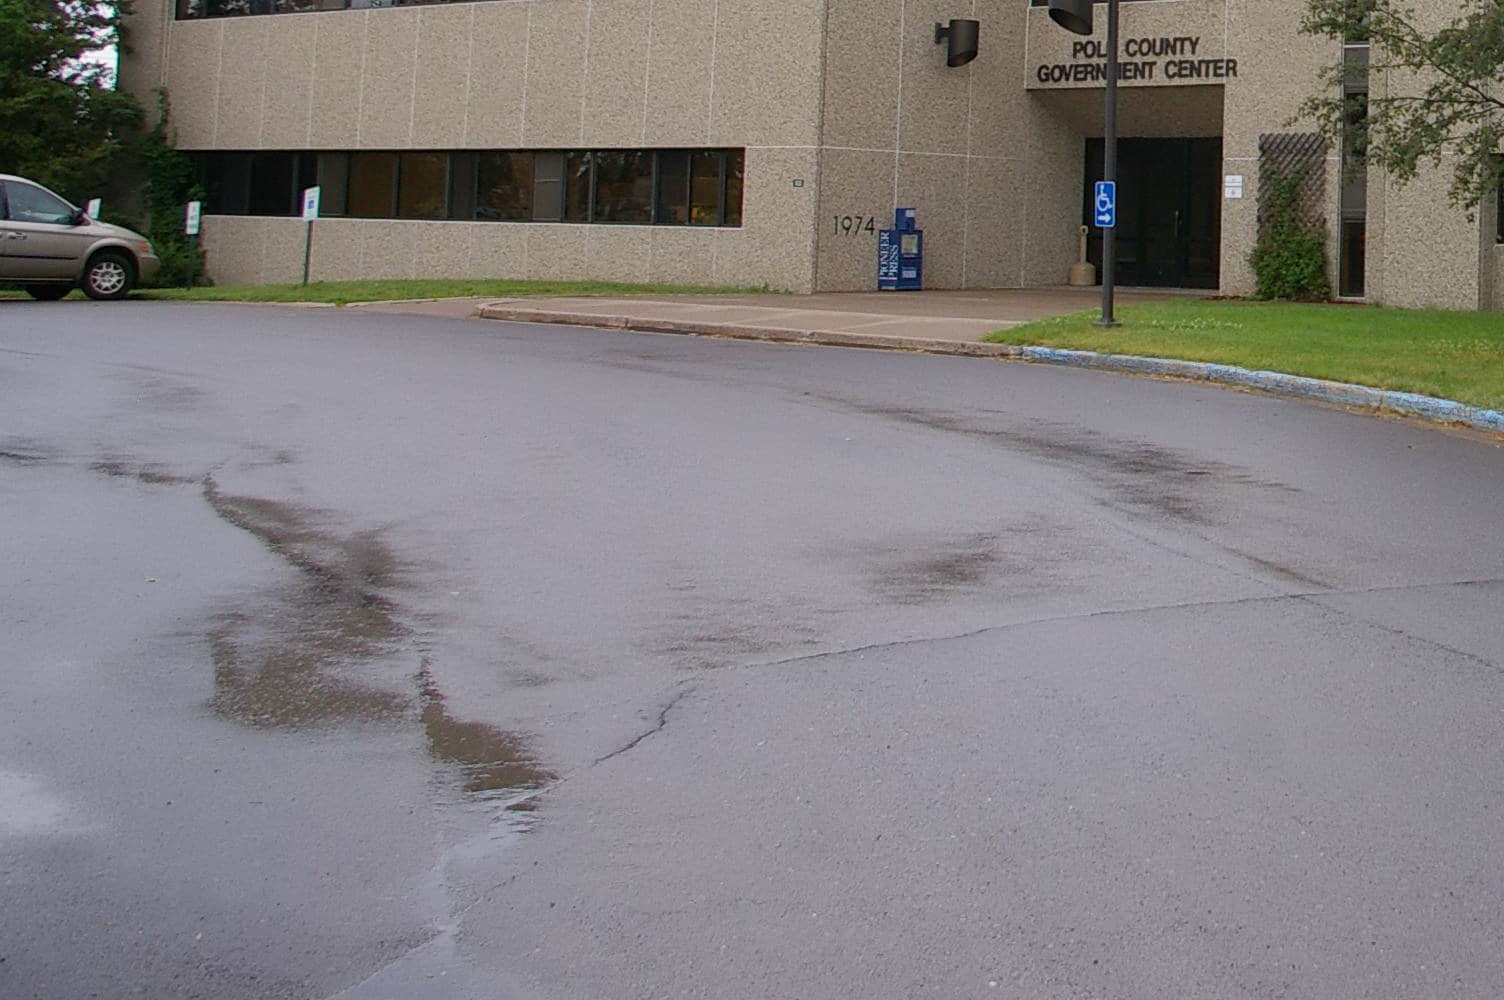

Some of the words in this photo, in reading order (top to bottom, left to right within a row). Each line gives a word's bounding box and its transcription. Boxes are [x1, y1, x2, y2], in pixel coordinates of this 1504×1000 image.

[1072, 41, 1109, 59] POL
[1124, 37, 1200, 57] COUNTY
[1163, 59, 1238, 79] CENTER
[833, 215, 875, 236] 1974
[879, 232, 890, 280] PIONEER
[888, 244, 899, 280] PRESS
